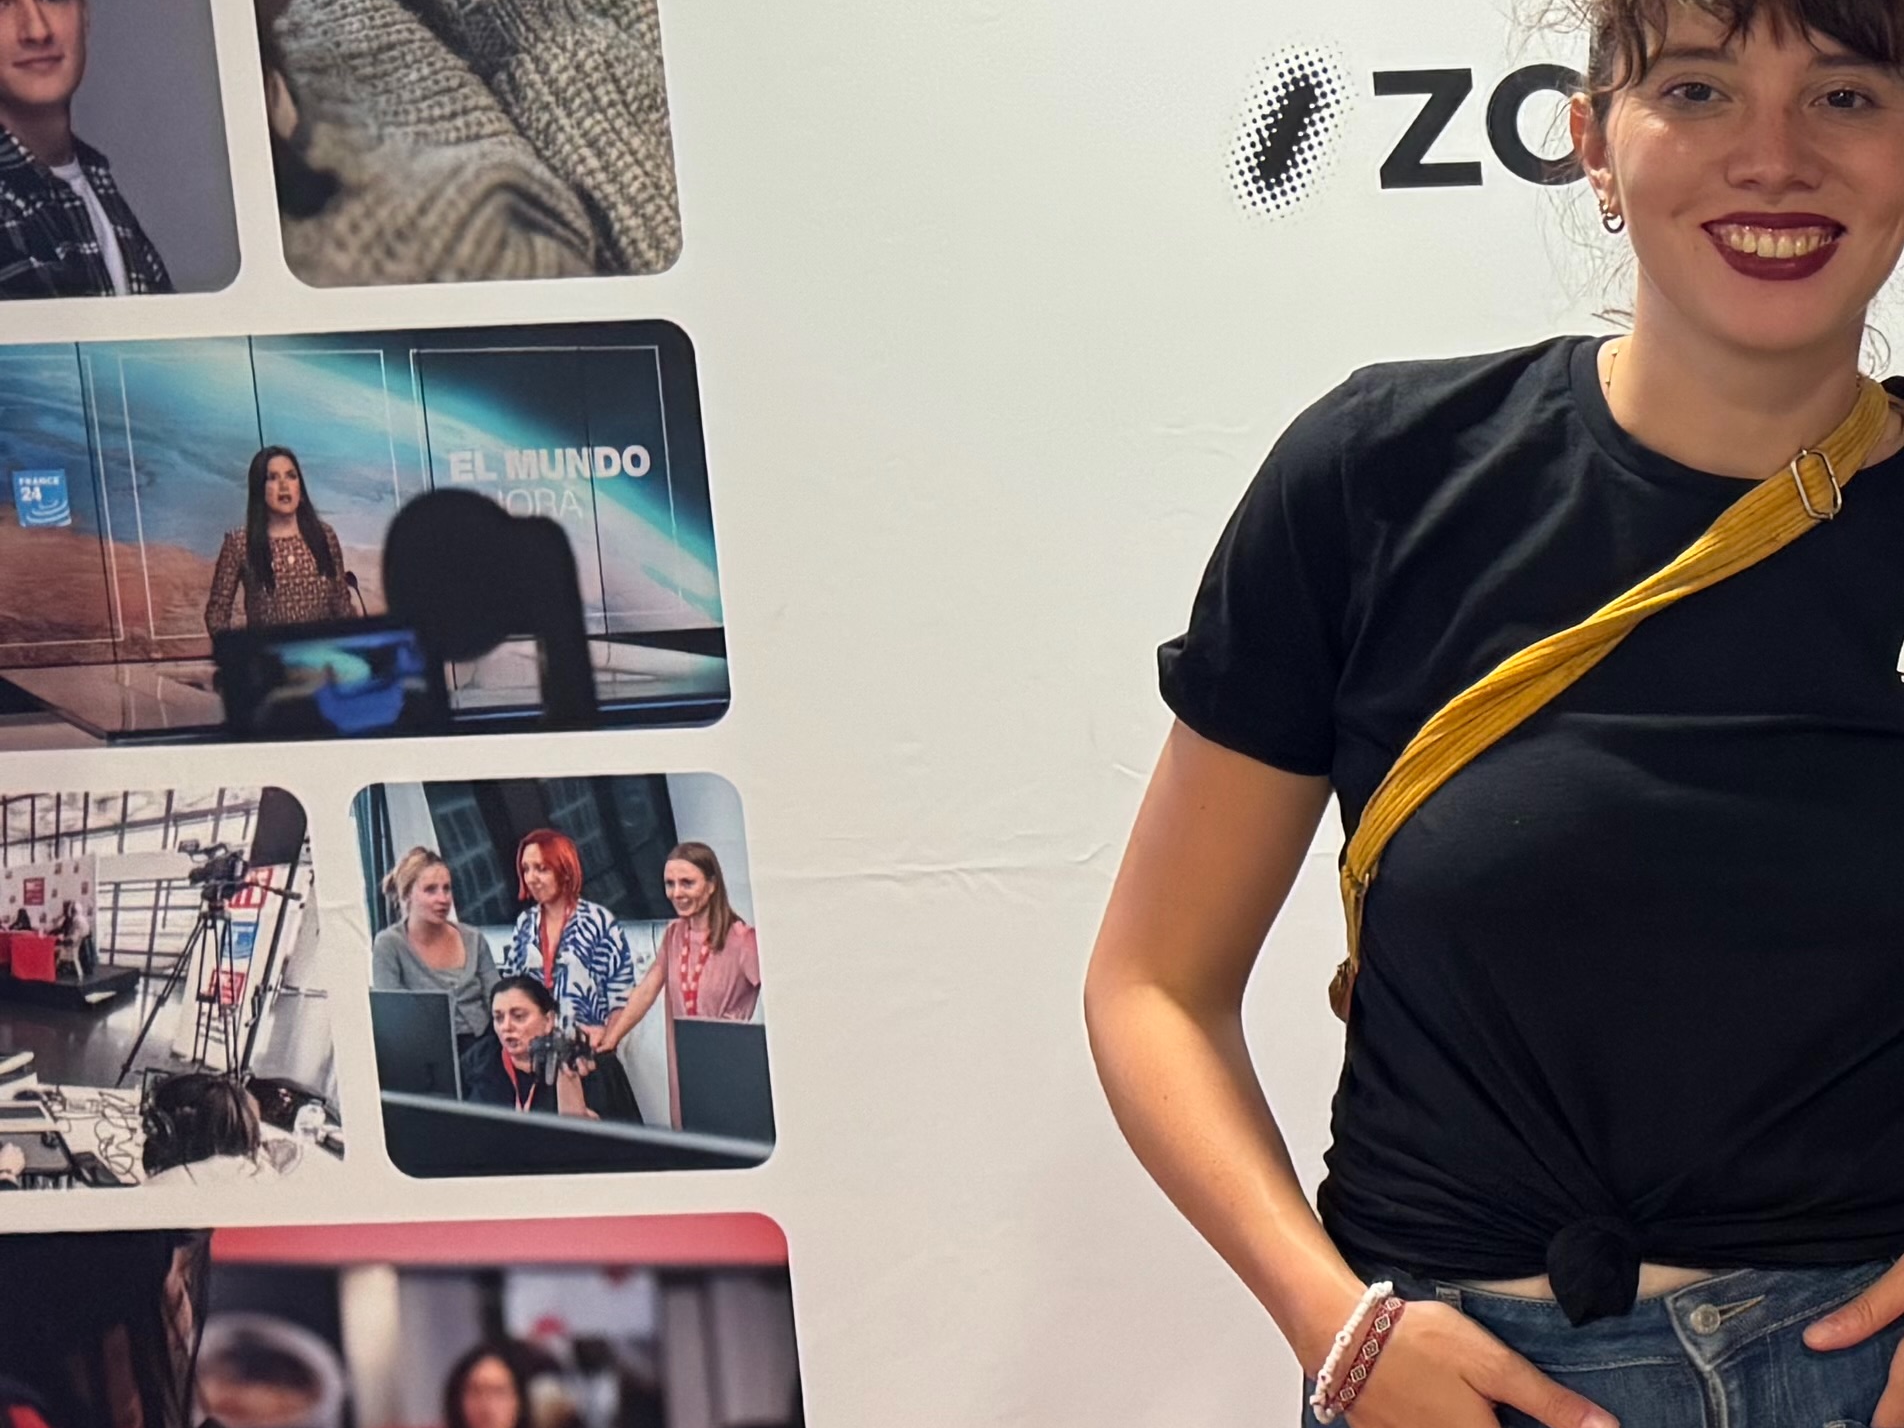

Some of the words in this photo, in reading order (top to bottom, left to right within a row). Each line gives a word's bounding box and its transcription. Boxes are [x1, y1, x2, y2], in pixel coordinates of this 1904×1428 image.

[1372, 63, 1590, 189] ZO
[449, 449, 498, 482] EL
[504, 444, 651, 481] MUNDO
[20, 486, 42, 502] 24
[498, 488, 583, 519] ORA
